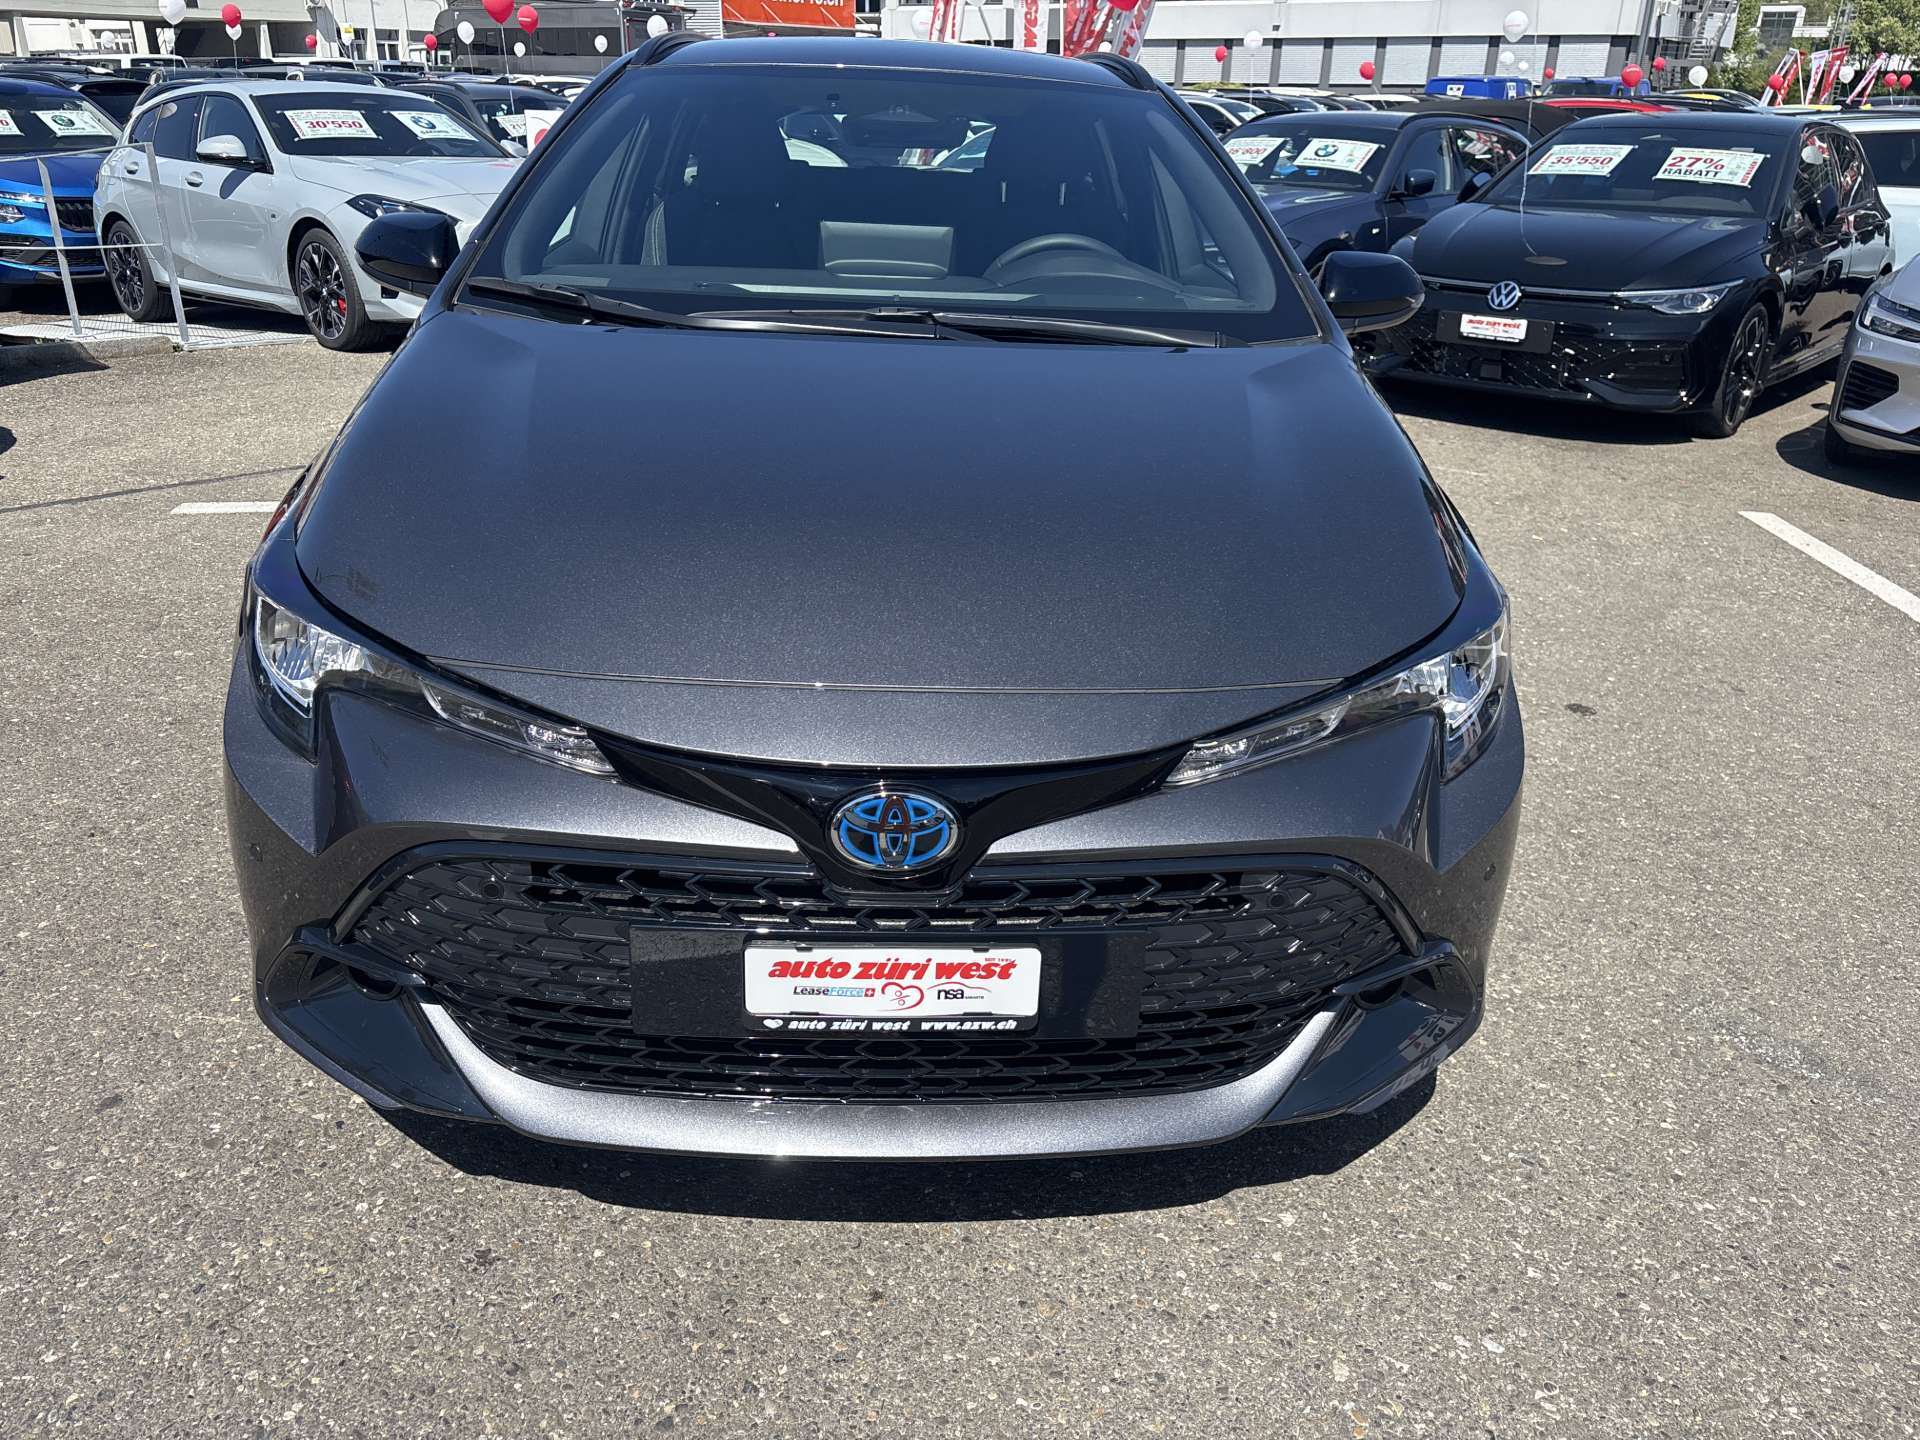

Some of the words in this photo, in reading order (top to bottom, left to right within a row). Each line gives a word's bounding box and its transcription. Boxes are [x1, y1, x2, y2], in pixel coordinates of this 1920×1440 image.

[305, 120, 363, 129] 30'550
[1551, 156, 1613, 165] 35'550
[1668, 156, 1725, 170] 27%
[1662, 168, 1721, 178] RABATT
[768, 957, 851, 979] auto
[852, 958, 931, 980] züri
[935, 958, 1017, 980] west
[793, 985, 864, 997] LeaseForce
[937, 987, 964, 1000] nsa
[788, 1019, 827, 1030] auto
[830, 1019, 868, 1030] züri
[871, 1020, 910, 1030] west
